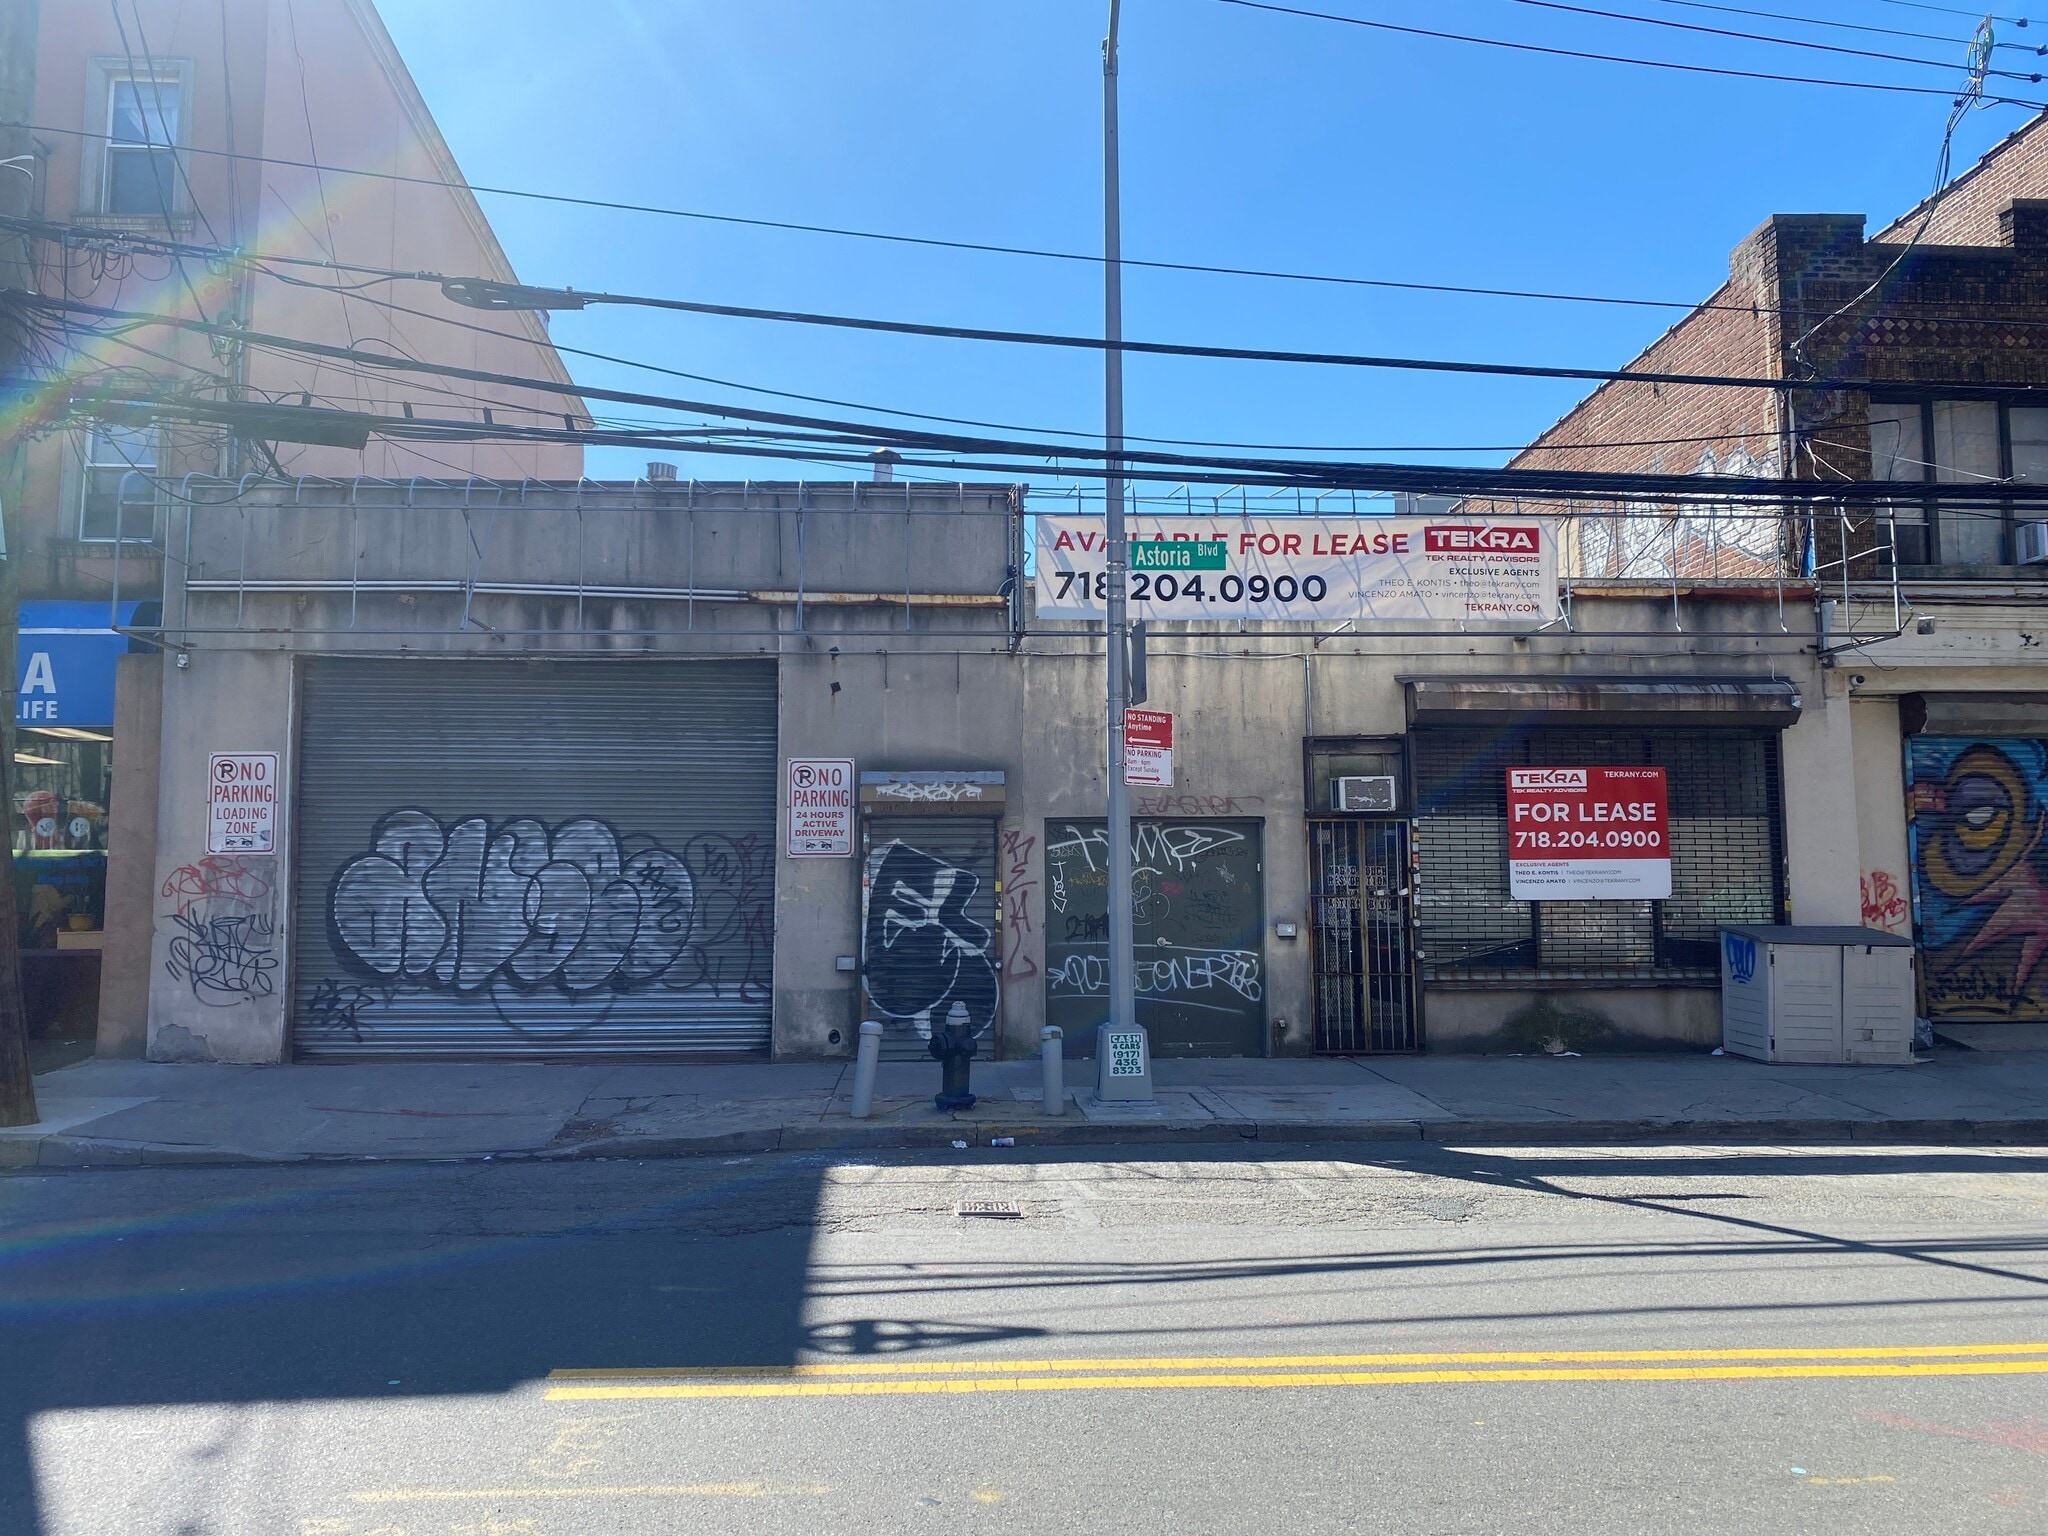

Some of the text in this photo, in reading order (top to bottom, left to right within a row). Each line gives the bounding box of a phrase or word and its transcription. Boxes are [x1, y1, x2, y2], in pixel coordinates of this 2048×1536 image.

[1430, 527, 1534, 549] TEKRA
[1239, 533, 1302, 556] FOR
[1311, 533, 1410, 556] LEASE
[1135, 544, 1218, 567] Astoria Blvd
[1425, 554, 1540, 563] TEK REALTY ADVISORS
[1449, 567, 1540, 577] EXCLUSIVE AGENTS
[1379, 579, 1406, 587] THEO
[1416, 579, 1452, 588] KONTIS
[1459, 579, 1540, 589] theo@tekrany.com
[1348, 590, 1540, 600] VINCENZO AMATO vincenzo@tekrany.com
[1464, 603, 1540, 612] TEKRANY.COM
[1127, 713, 1167, 724] NO STANDING
[1127, 723, 1152, 732] Anytime
[1127, 749, 1162, 759] NO PARKING
[240, 762, 266, 781] NO
[1127, 765, 1160, 775] Except Sunday
[818, 768, 842, 786] NO
[1515, 770, 1582, 784] TEKRA
[214, 785, 272, 803] PARKING
[793, 789, 849, 808] PARKING
[216, 807, 267, 820] LOADING
[796, 811, 844, 819] 24 HOURS
[1514, 802, 1657, 823] FOR LEASE
[225, 821, 258, 834] ZONE
[802, 820, 838, 828] ACTIVE
[795, 829, 845, 837] DRIVEWAY
[1515, 830, 1661, 848] 718.204.0900
[1113, 1050, 1140, 1058] (917)
[1115, 1058, 1139, 1066] 436
[1112, 1066, 1142, 1074] 8323
